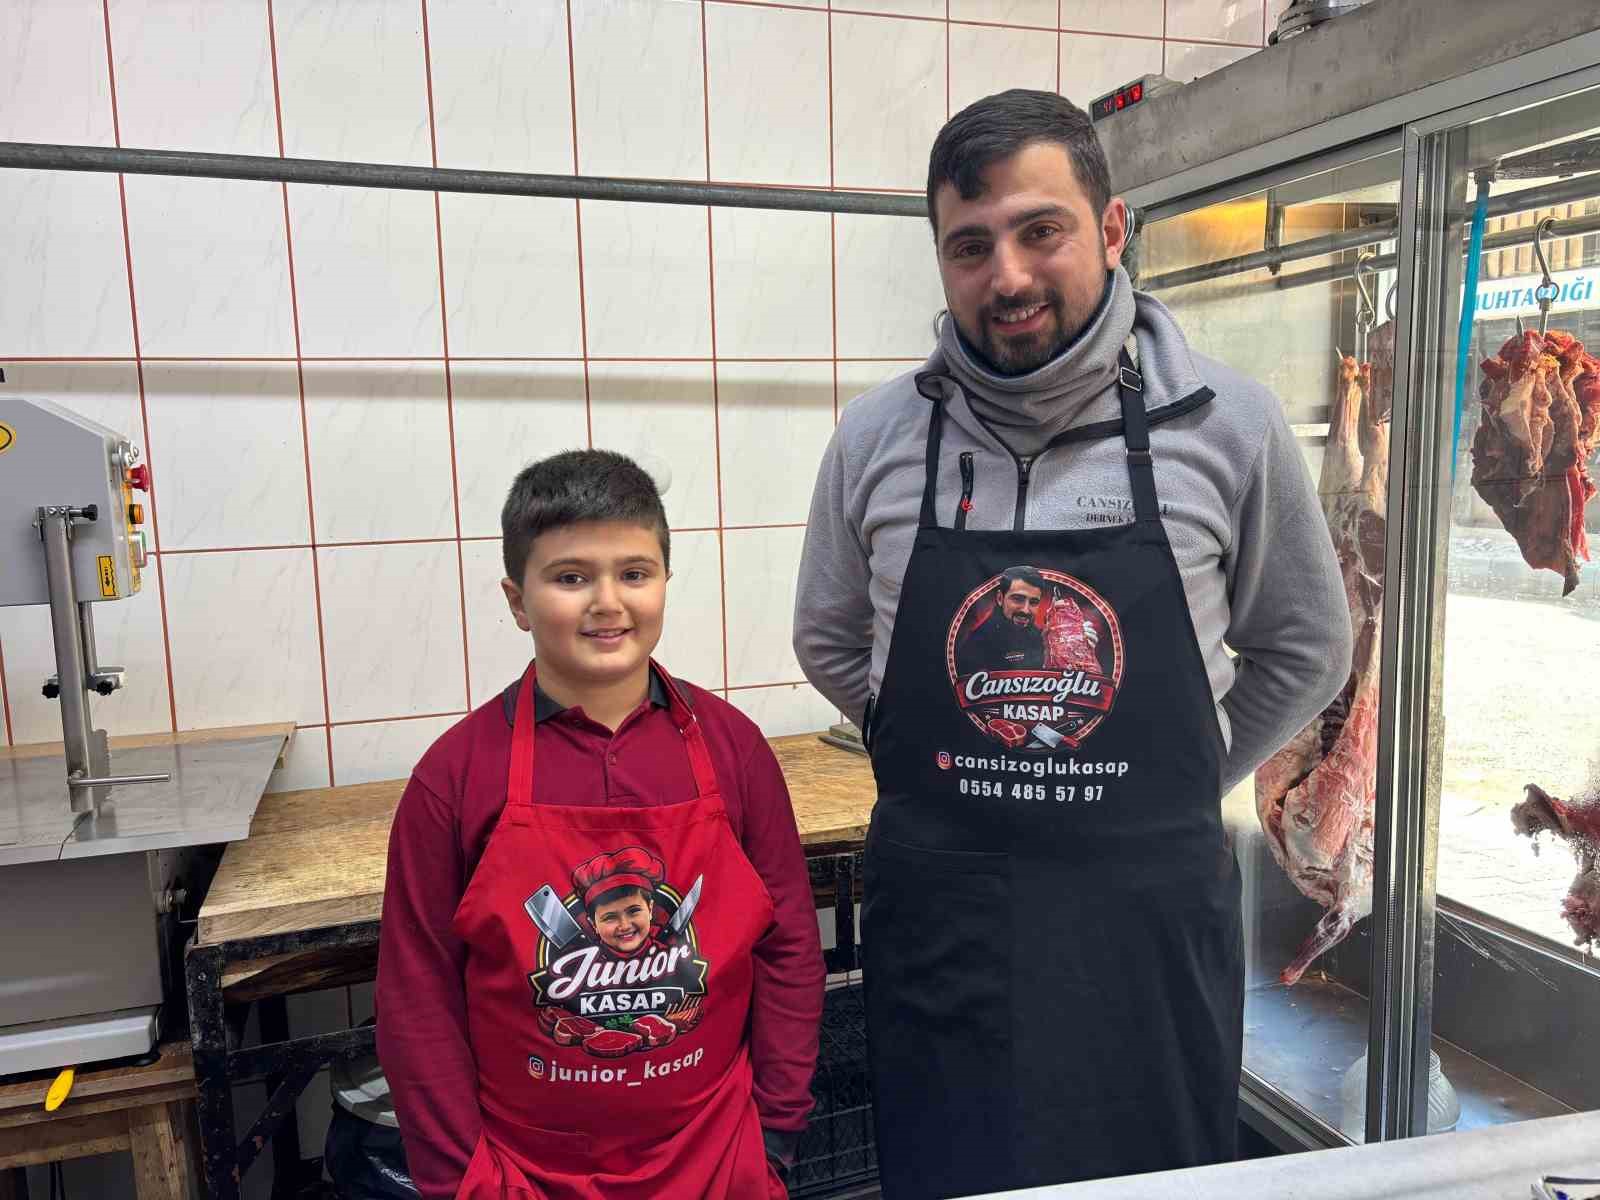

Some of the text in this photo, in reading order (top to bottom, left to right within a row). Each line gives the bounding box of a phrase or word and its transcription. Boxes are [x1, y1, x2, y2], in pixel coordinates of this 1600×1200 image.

[1475, 276, 1593, 311] UHTALIĞI
[965, 670, 1101, 703] Cansızoğlu
[1003, 703, 1065, 721] KASAP
[954, 755, 1129, 777] cansizoglukasap
[959, 778, 1104, 801] 0554 485 57 97
[548, 943, 690, 999] Junior
[580, 991, 666, 1015] KASAP
[549, 1047, 705, 1086] junior_kasap
